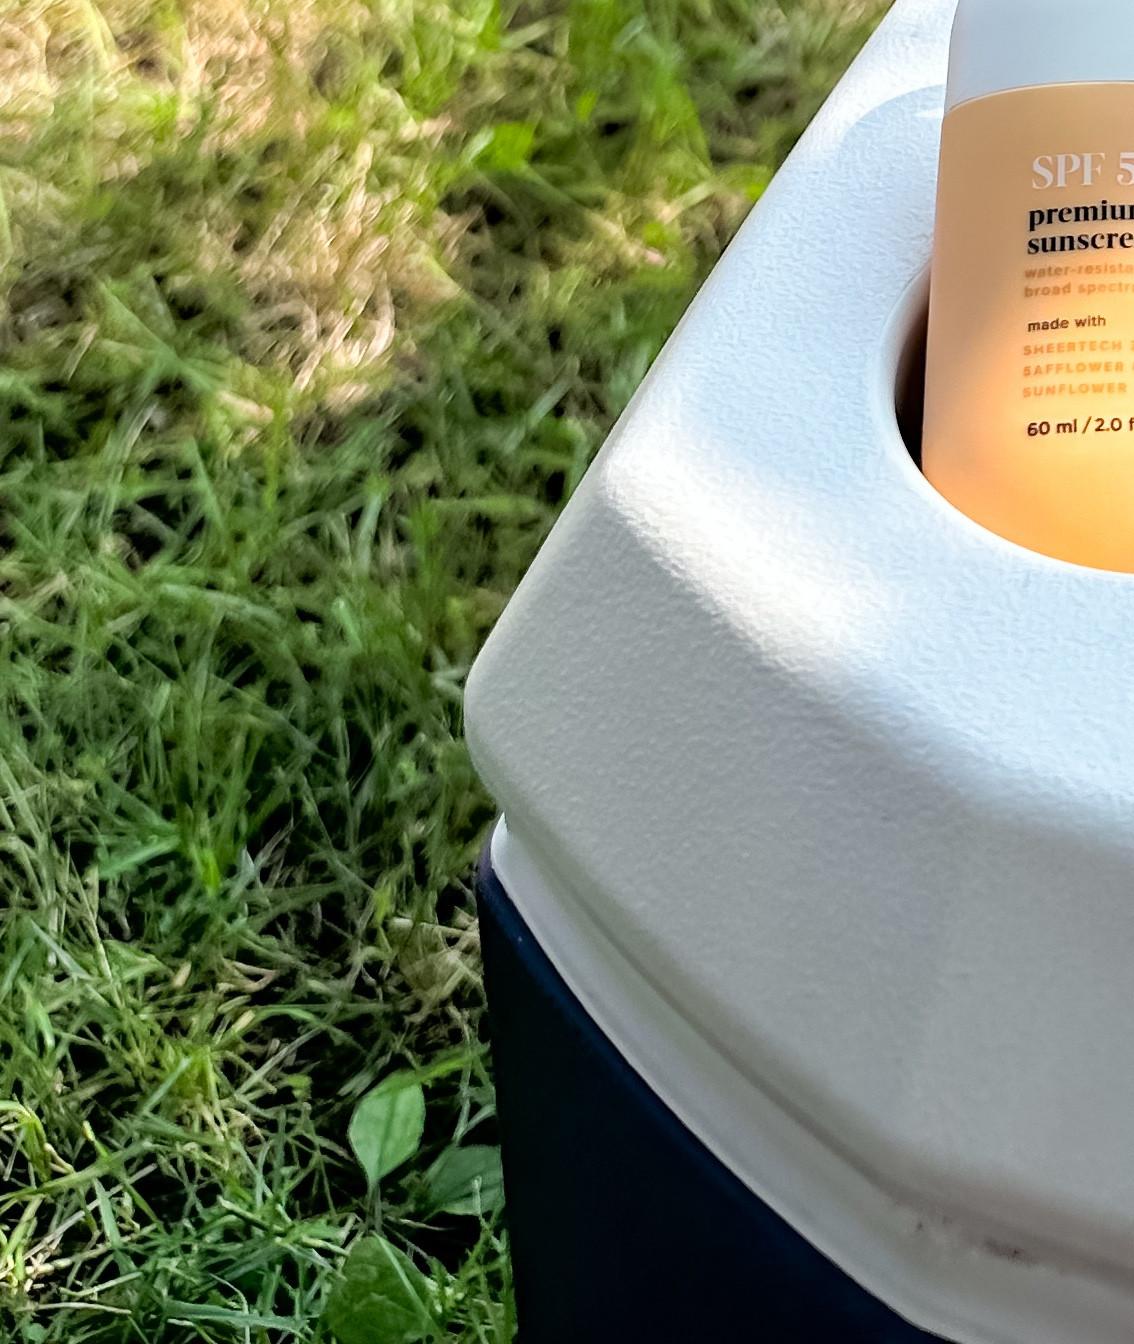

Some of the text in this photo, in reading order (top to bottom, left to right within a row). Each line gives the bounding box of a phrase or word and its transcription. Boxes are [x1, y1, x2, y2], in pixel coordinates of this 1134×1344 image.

[1031, 152, 1105, 189] SPF
[1024, 281, 1071, 298] broad
[1027, 315, 1107, 332] made with
[1023, 341, 1122, 356] SHEERTECH
[1023, 362, 1124, 377] SAFFLOWER
[1022, 383, 1128, 398] SUNFLOWER
[1027, 421, 1051, 436] 60
[1056, 418, 1077, 434] ml
[1094, 417, 1123, 432] 2.0
